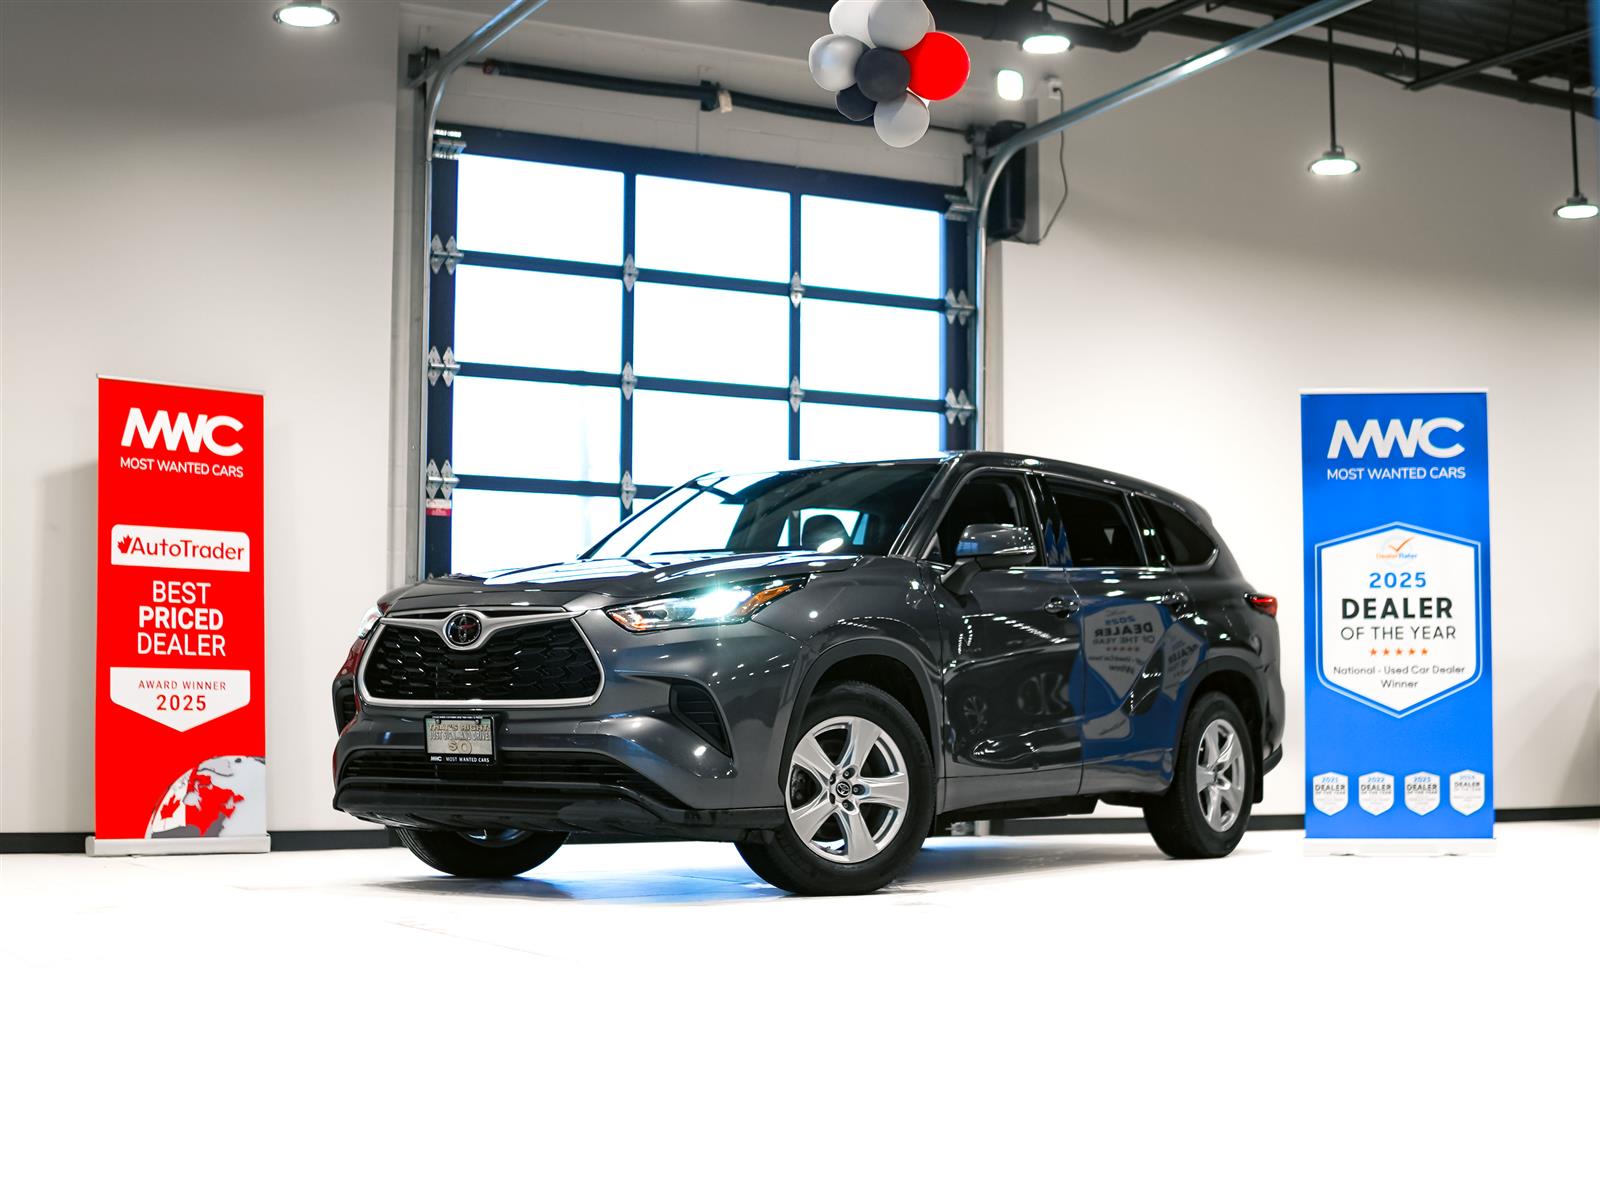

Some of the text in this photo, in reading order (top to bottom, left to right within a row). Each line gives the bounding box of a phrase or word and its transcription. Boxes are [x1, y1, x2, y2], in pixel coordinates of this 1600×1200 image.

[121, 407, 244, 456] MWC
[1327, 417, 1465, 459] MWC
[120, 457, 244, 478] MOST WANTED CARS
[1327, 466, 1466, 480] MOST WANTED CARS
[131, 537, 244, 561] AutoTrader
[1369, 572, 1427, 589] 2025
[152, 580, 211, 604] BEST
[1341, 597, 1453, 620] DEALER
[139, 605, 224, 631] PRICED
[1340, 625, 1456, 641] OF THE YEAR
[137, 632, 226, 657] DEALER
[1333, 666, 1376, 675] National
[1384, 666, 1409, 675] Used
[1411, 666, 1429, 674] Car
[1432, 665, 1465, 674] Dealer
[138, 680, 226, 691] AWARD WINNER
[1381, 679, 1418, 689] Winner
[156, 694, 207, 711] 2025
[1315, 784, 1346, 792] DEALER
[1360, 784, 1391, 792] DEALER
[1406, 784, 1437, 792] DEALER
